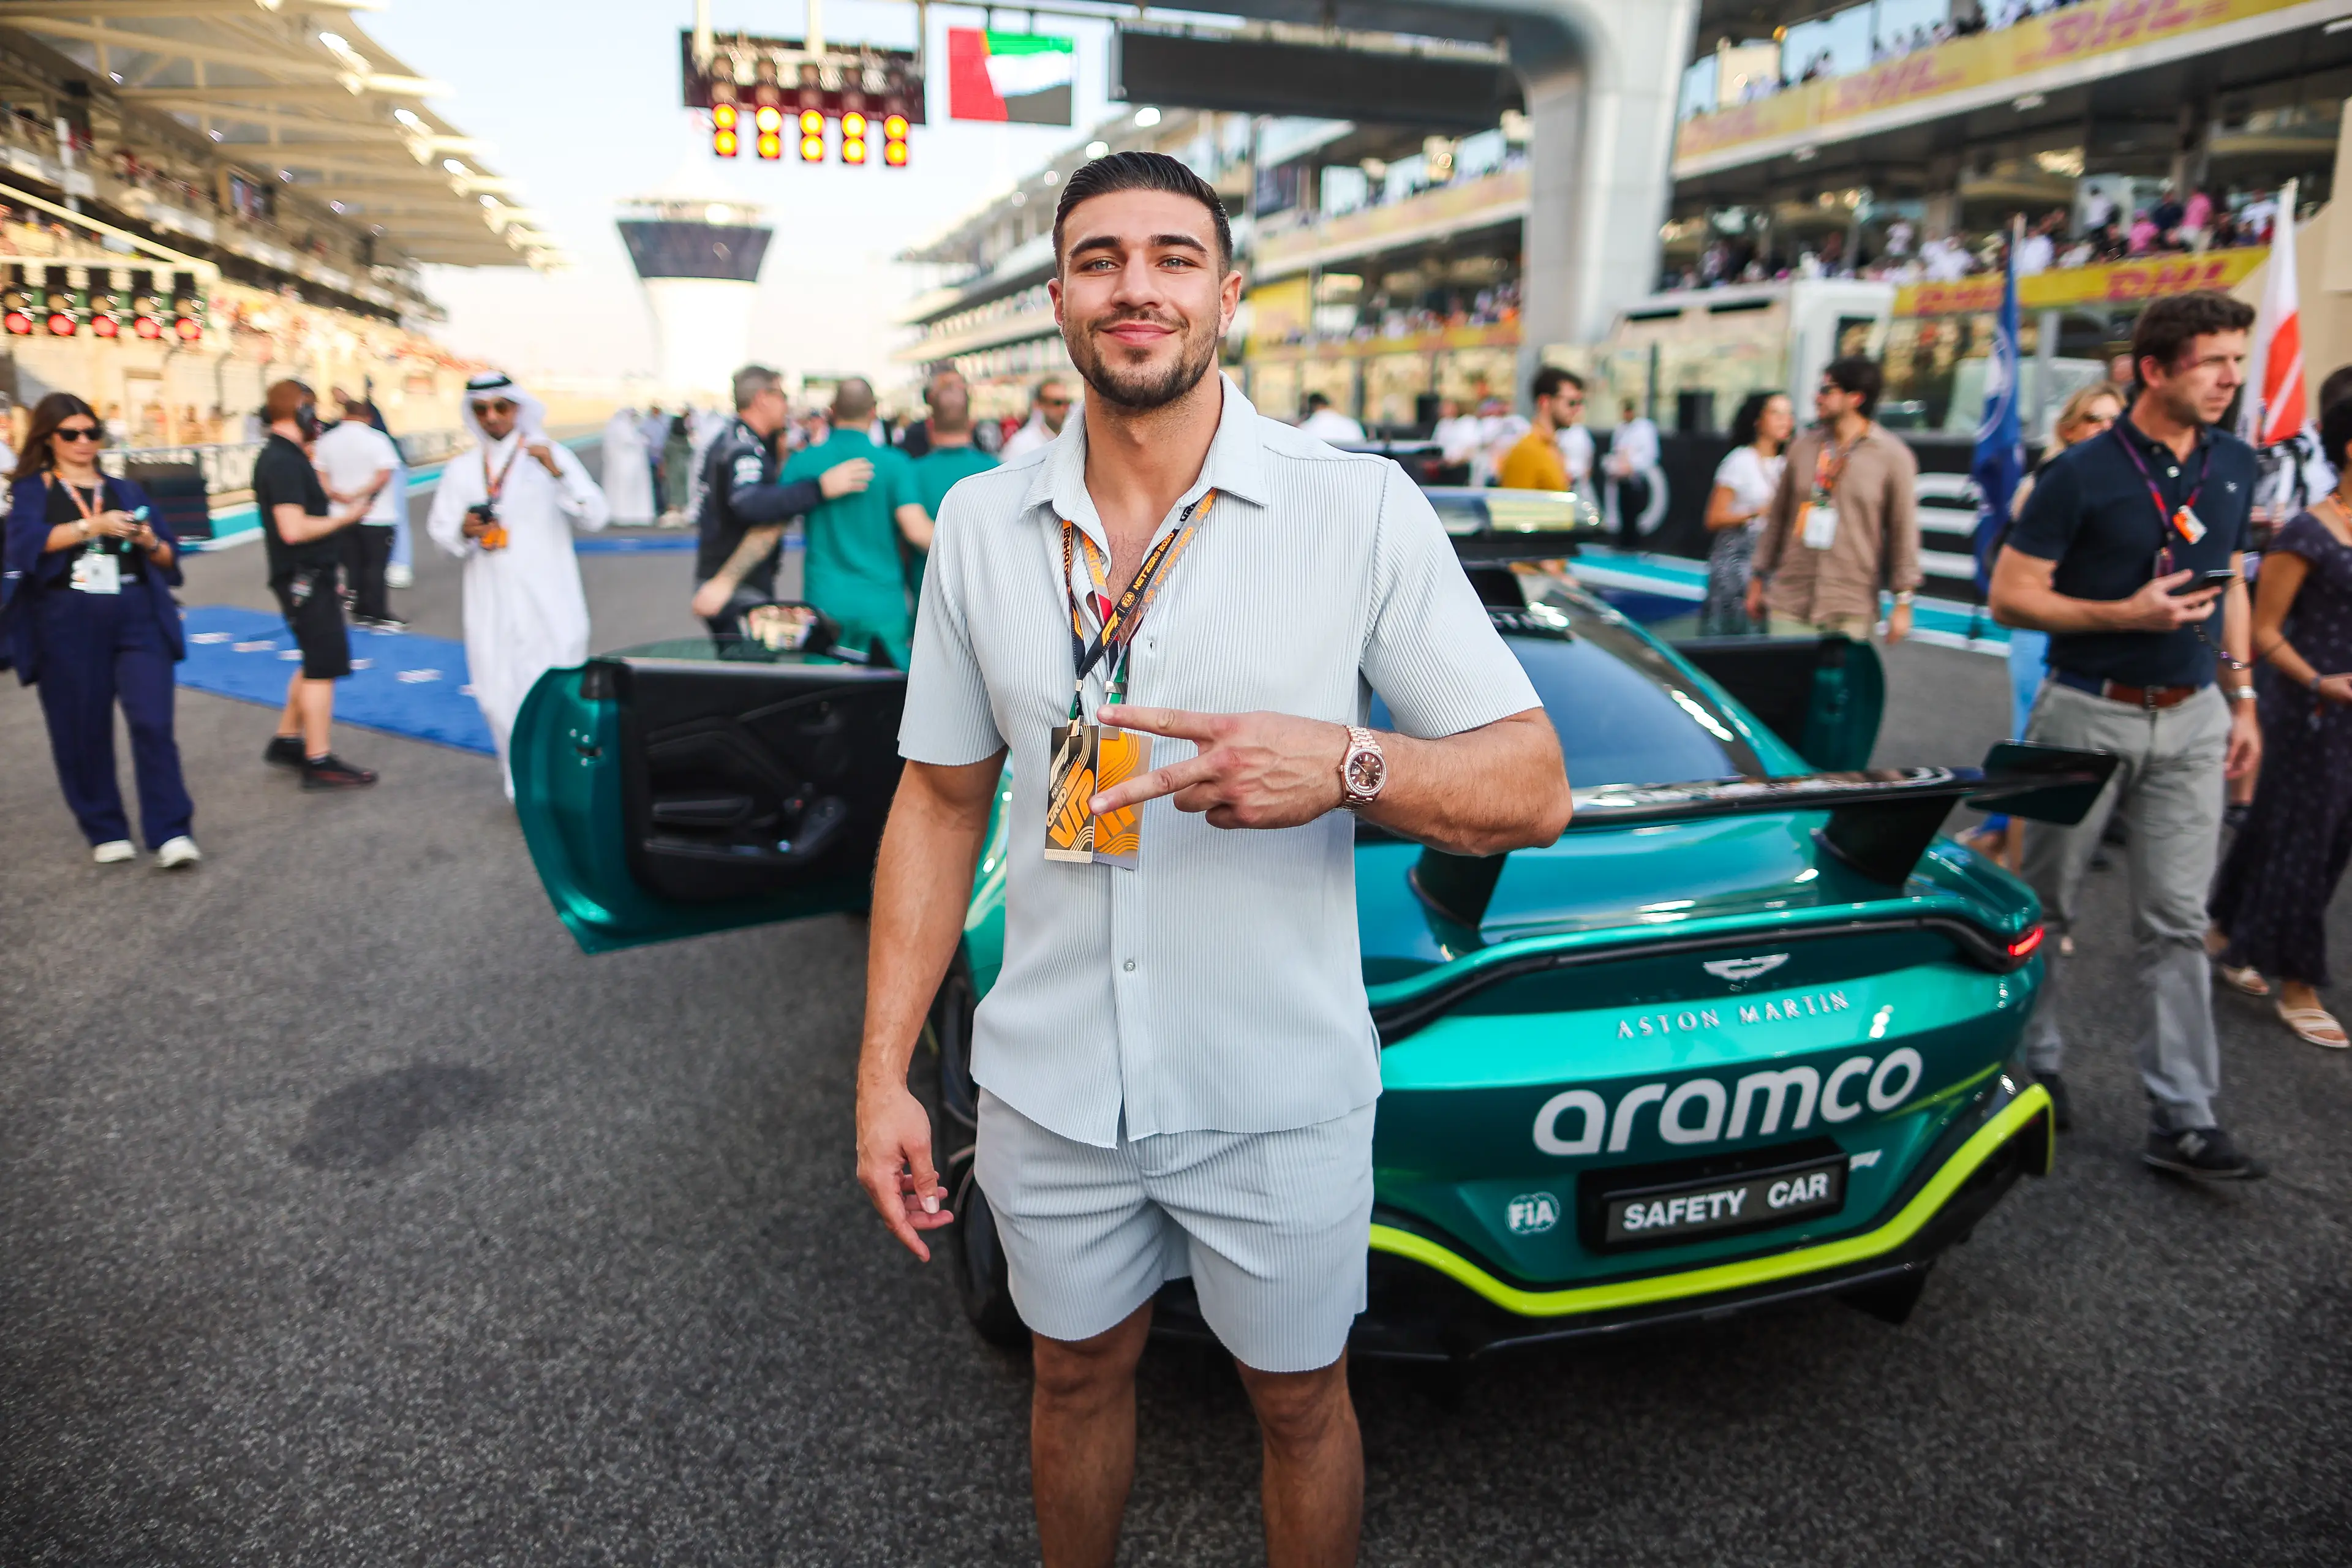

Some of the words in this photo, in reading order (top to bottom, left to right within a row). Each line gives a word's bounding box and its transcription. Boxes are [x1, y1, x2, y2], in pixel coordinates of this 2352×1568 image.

[2106, 262, 2233, 301] DHL
[1158, 532, 1174, 552] 2030
[1178, 527, 1194, 548] 2030
[1046, 786, 1068, 827] GRID
[1049, 768, 1095, 848] VIP
[1617, 1008, 1721, 1040] ASTON
[1738, 990, 1850, 1026] MARTIN
[1533, 1047, 1923, 1156] aramco
[1623, 1188, 1747, 1230] SAFETY
[1767, 1172, 1829, 1208] CAR
